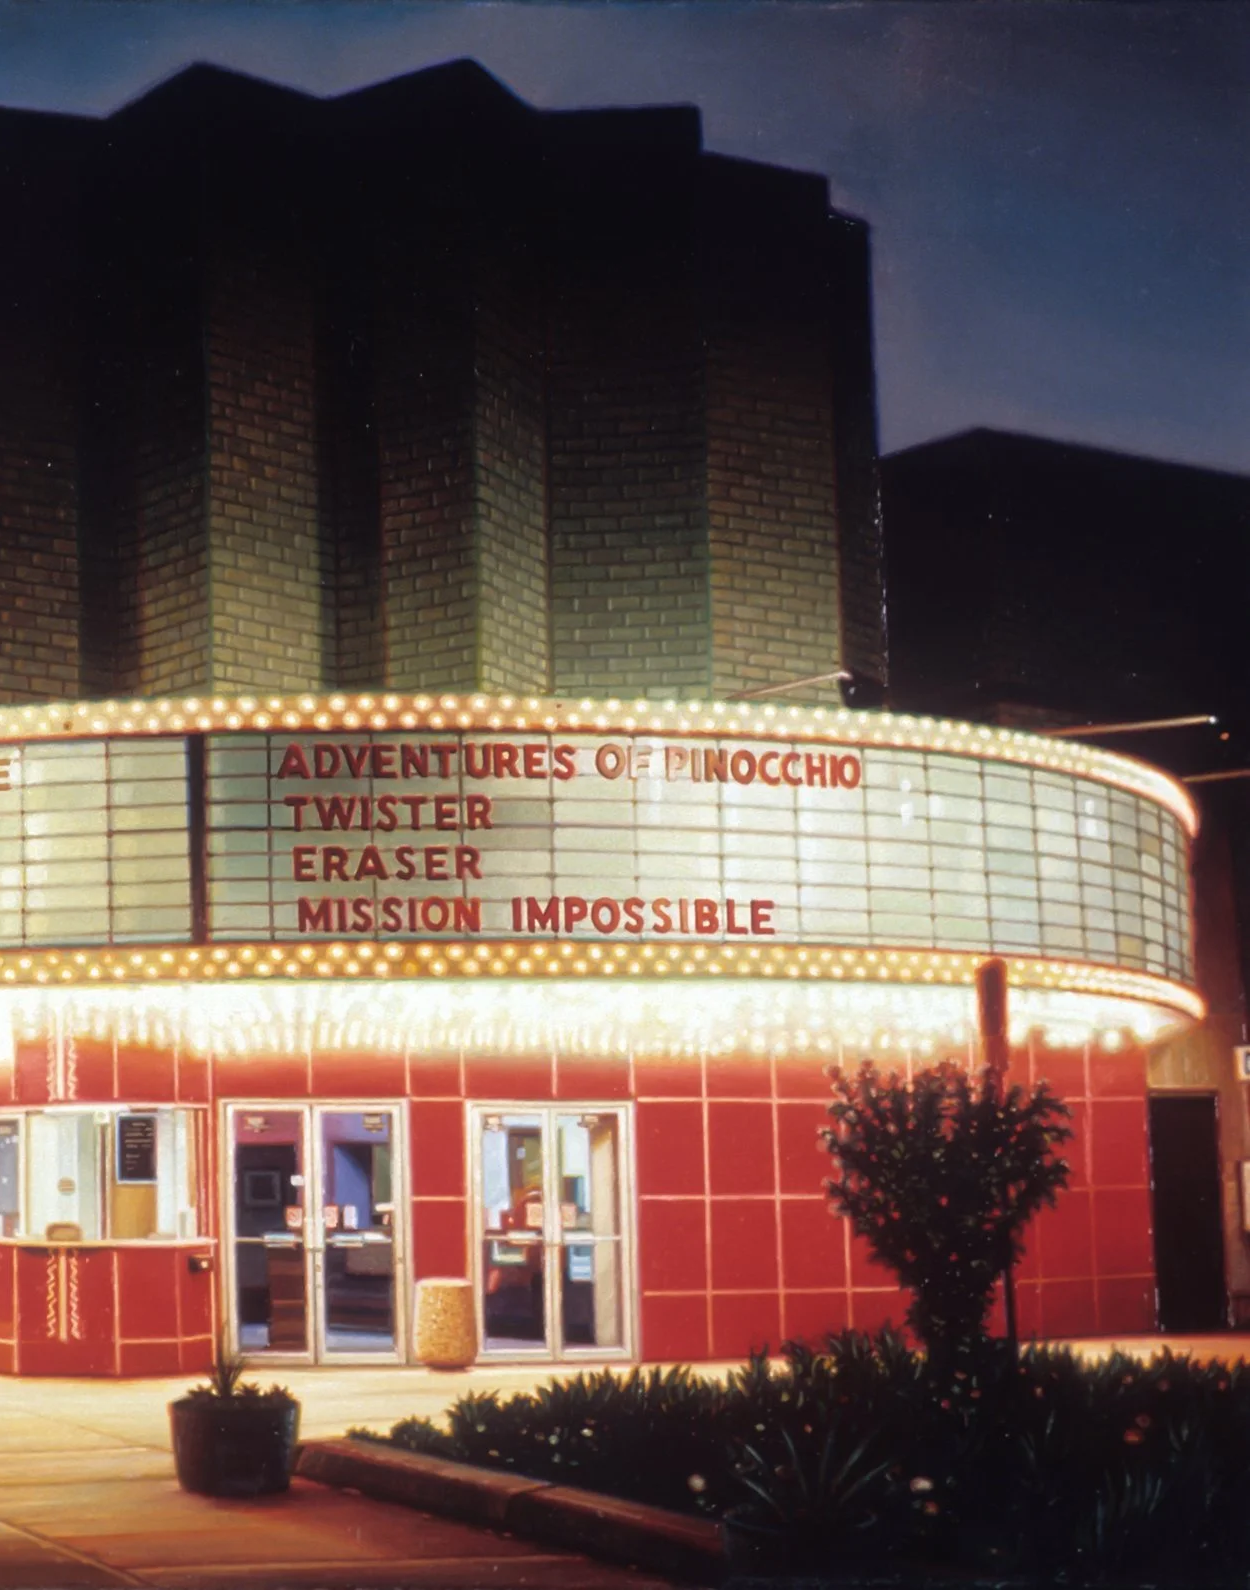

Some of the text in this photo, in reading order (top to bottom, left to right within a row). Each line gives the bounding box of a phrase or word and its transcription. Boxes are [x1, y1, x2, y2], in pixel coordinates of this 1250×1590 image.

[277, 742, 862, 789] ADVENTURES OF PINOCCHIO
[284, 794, 494, 831] TWISTER
[292, 845, 482, 882] ERASER
[298, 896, 776, 935] MISSION IMPOSSIBLE
